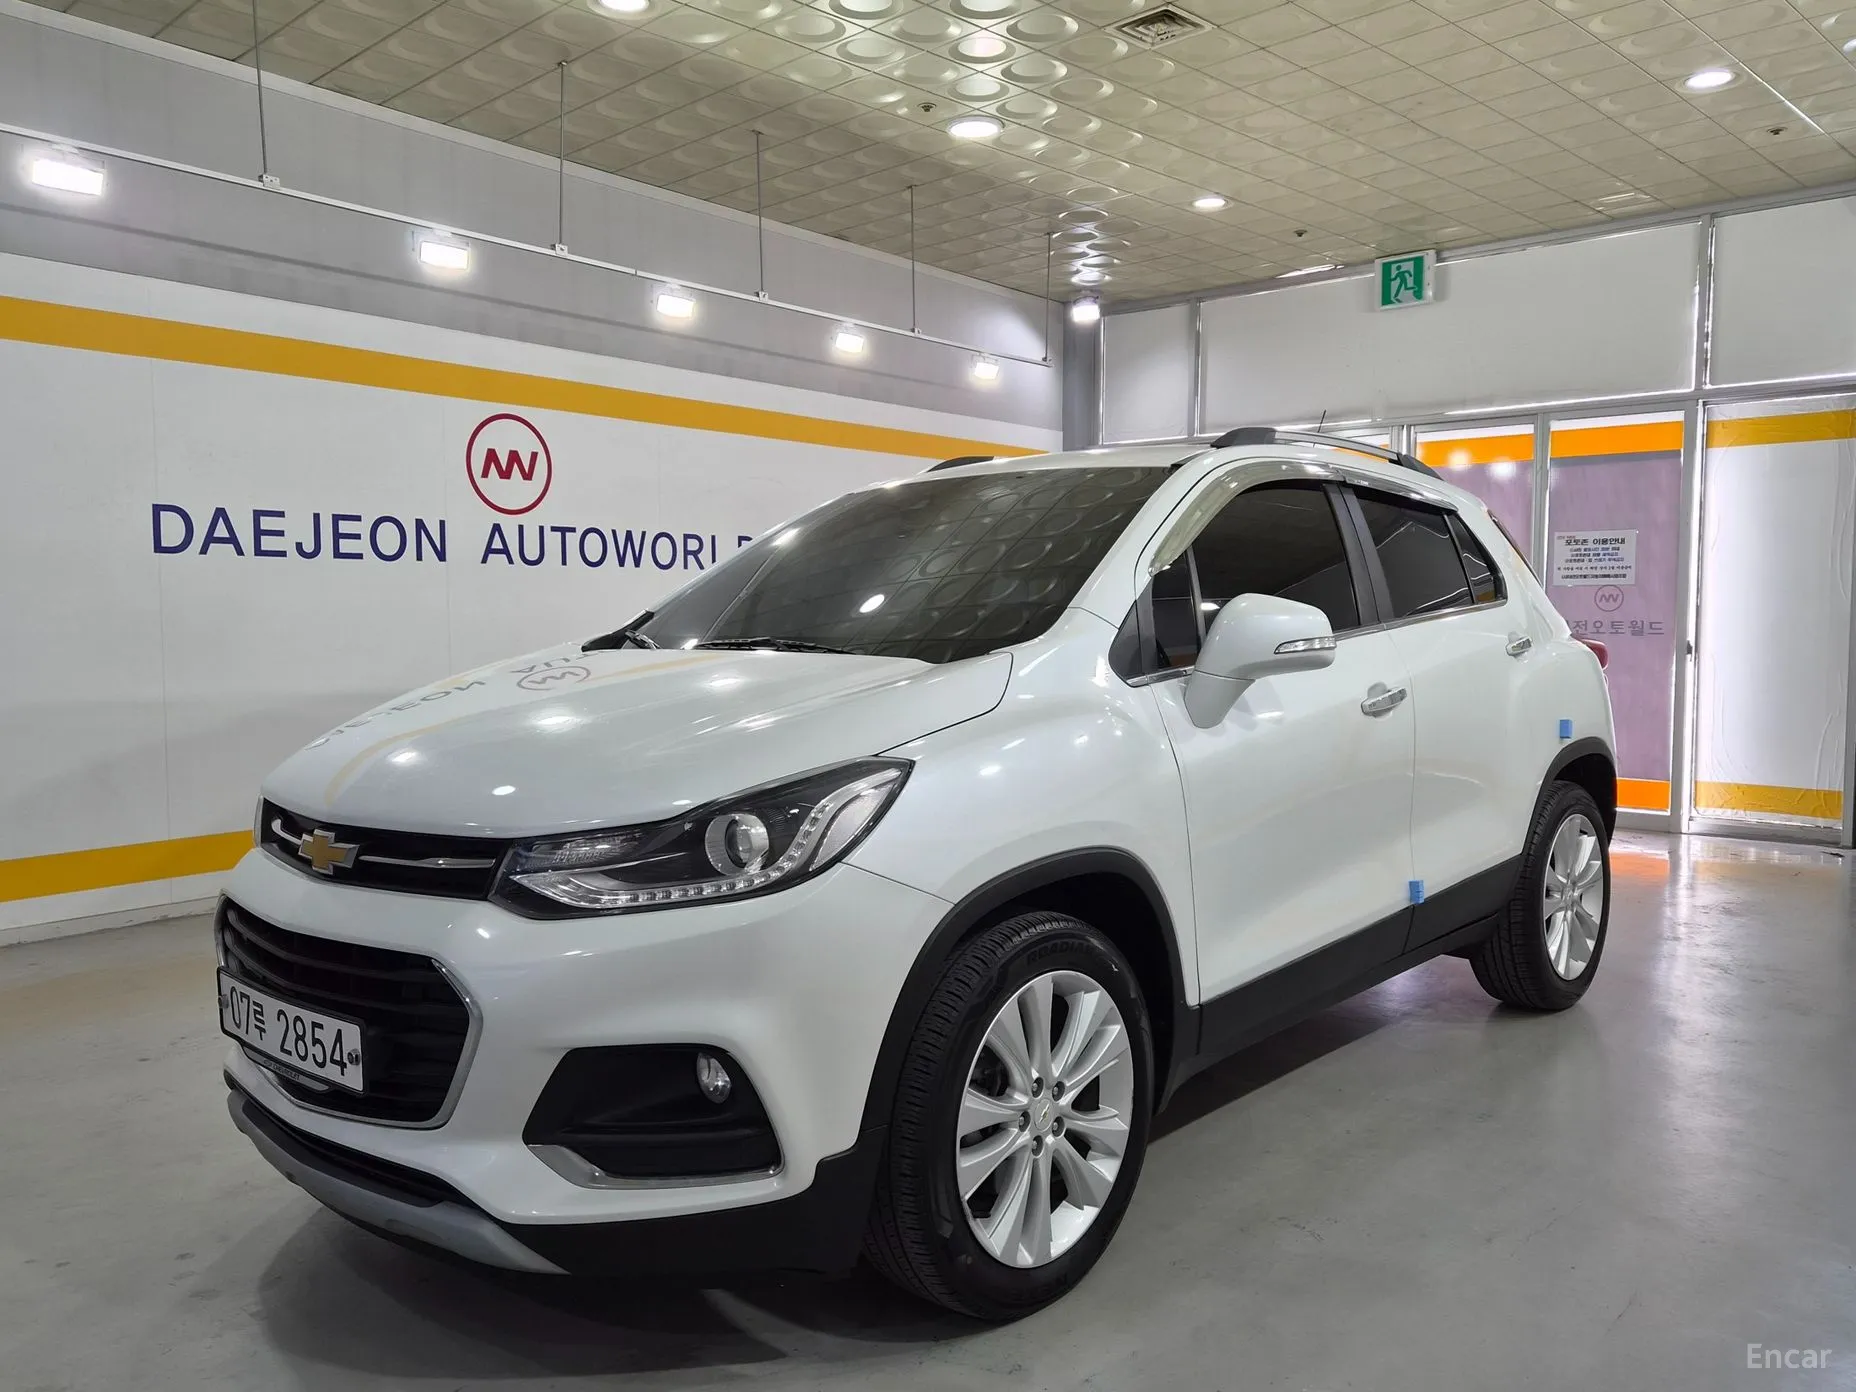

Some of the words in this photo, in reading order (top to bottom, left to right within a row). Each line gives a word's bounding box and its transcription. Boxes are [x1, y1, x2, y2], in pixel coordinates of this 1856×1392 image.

[152, 503, 447, 563] DAEJEON
[481, 523, 753, 571] AUTOWORL
[1568, 619, 1665, 636] 전오토월드
[230, 986, 267, 1041] 07루
[277, 1009, 348, 1077] 2854
